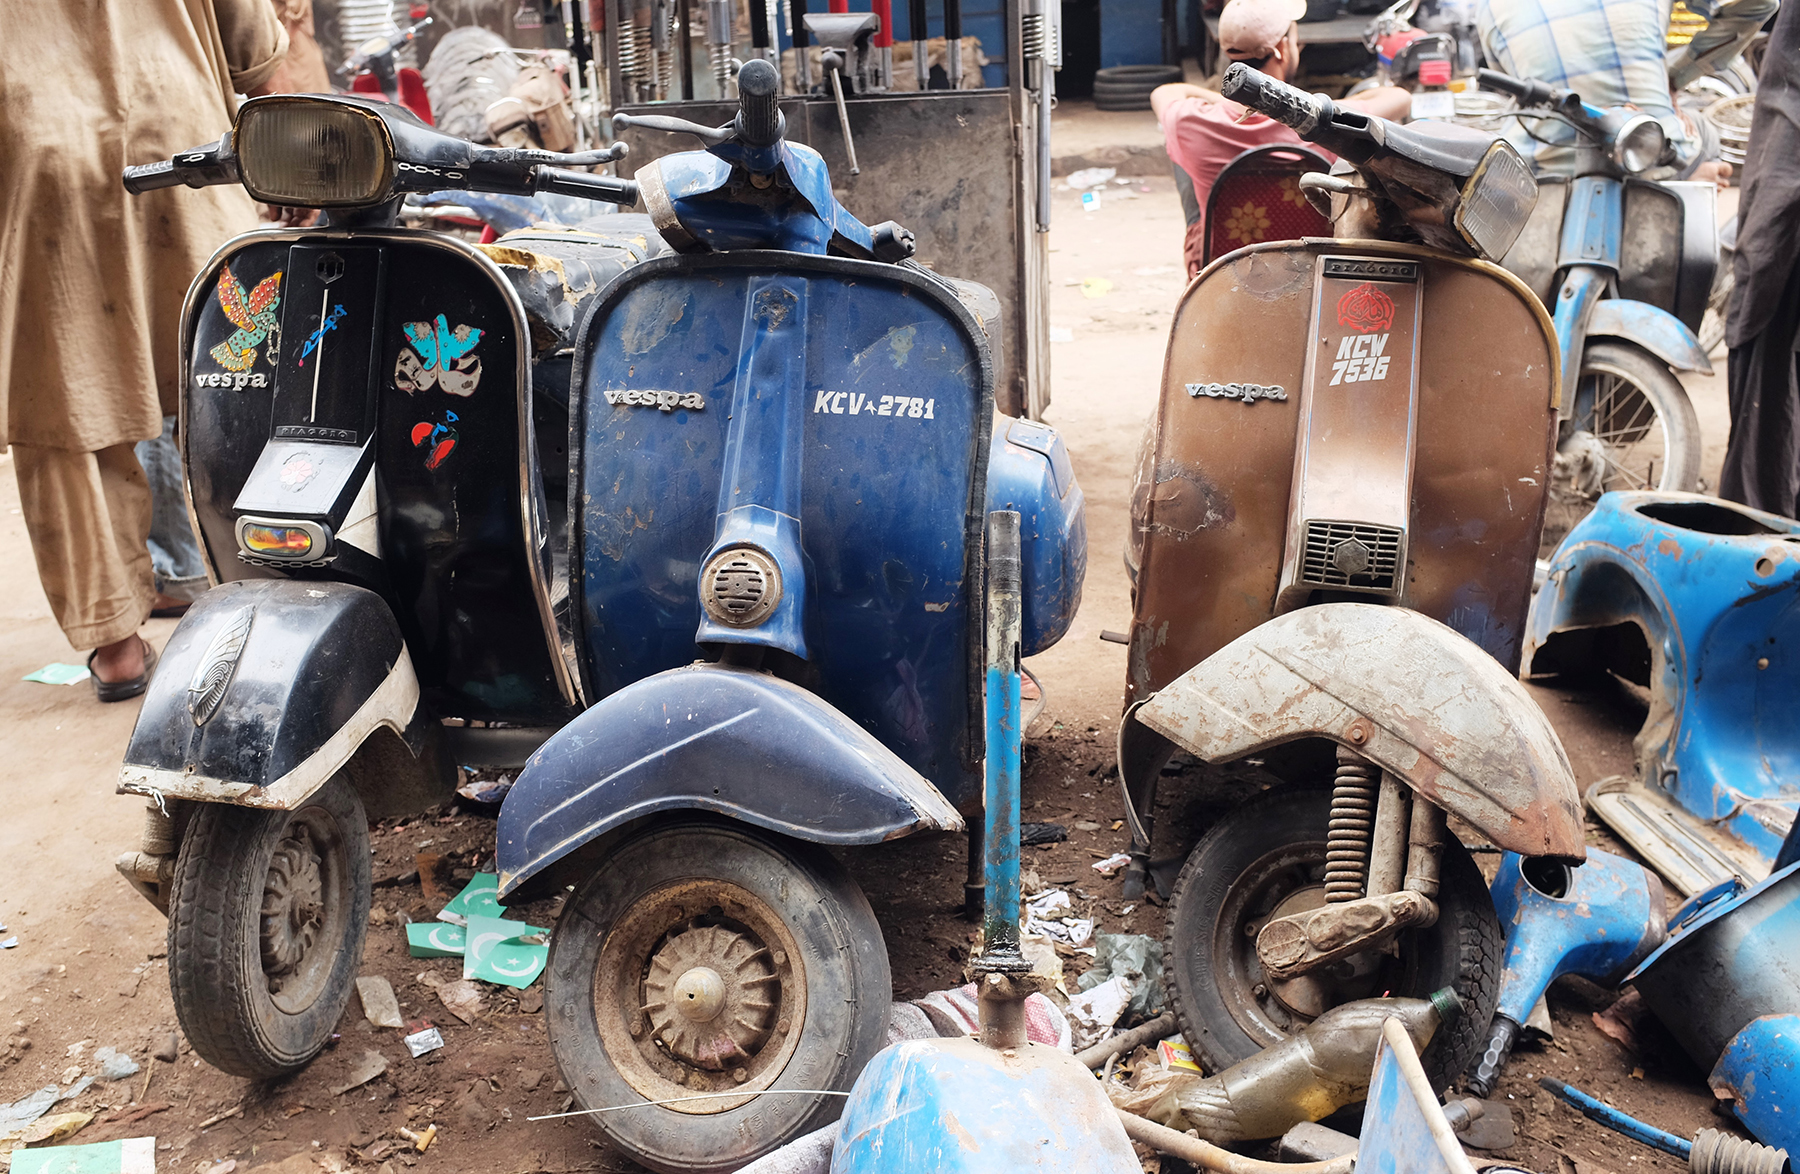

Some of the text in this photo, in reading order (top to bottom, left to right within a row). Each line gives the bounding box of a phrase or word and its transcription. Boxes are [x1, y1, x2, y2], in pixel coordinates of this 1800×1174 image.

[1331, 262, 1412, 276] PIAGGIO
[1335, 333, 1390, 360] KCW
[195, 372, 269, 392] vespa
[1328, 356, 1391, 387] 7536
[603, 389, 706, 411] vespa
[1185, 382, 1288, 403] vespa
[813, 390, 935, 419] KCV 2781
[281, 427, 349, 439] PIAGGIO
